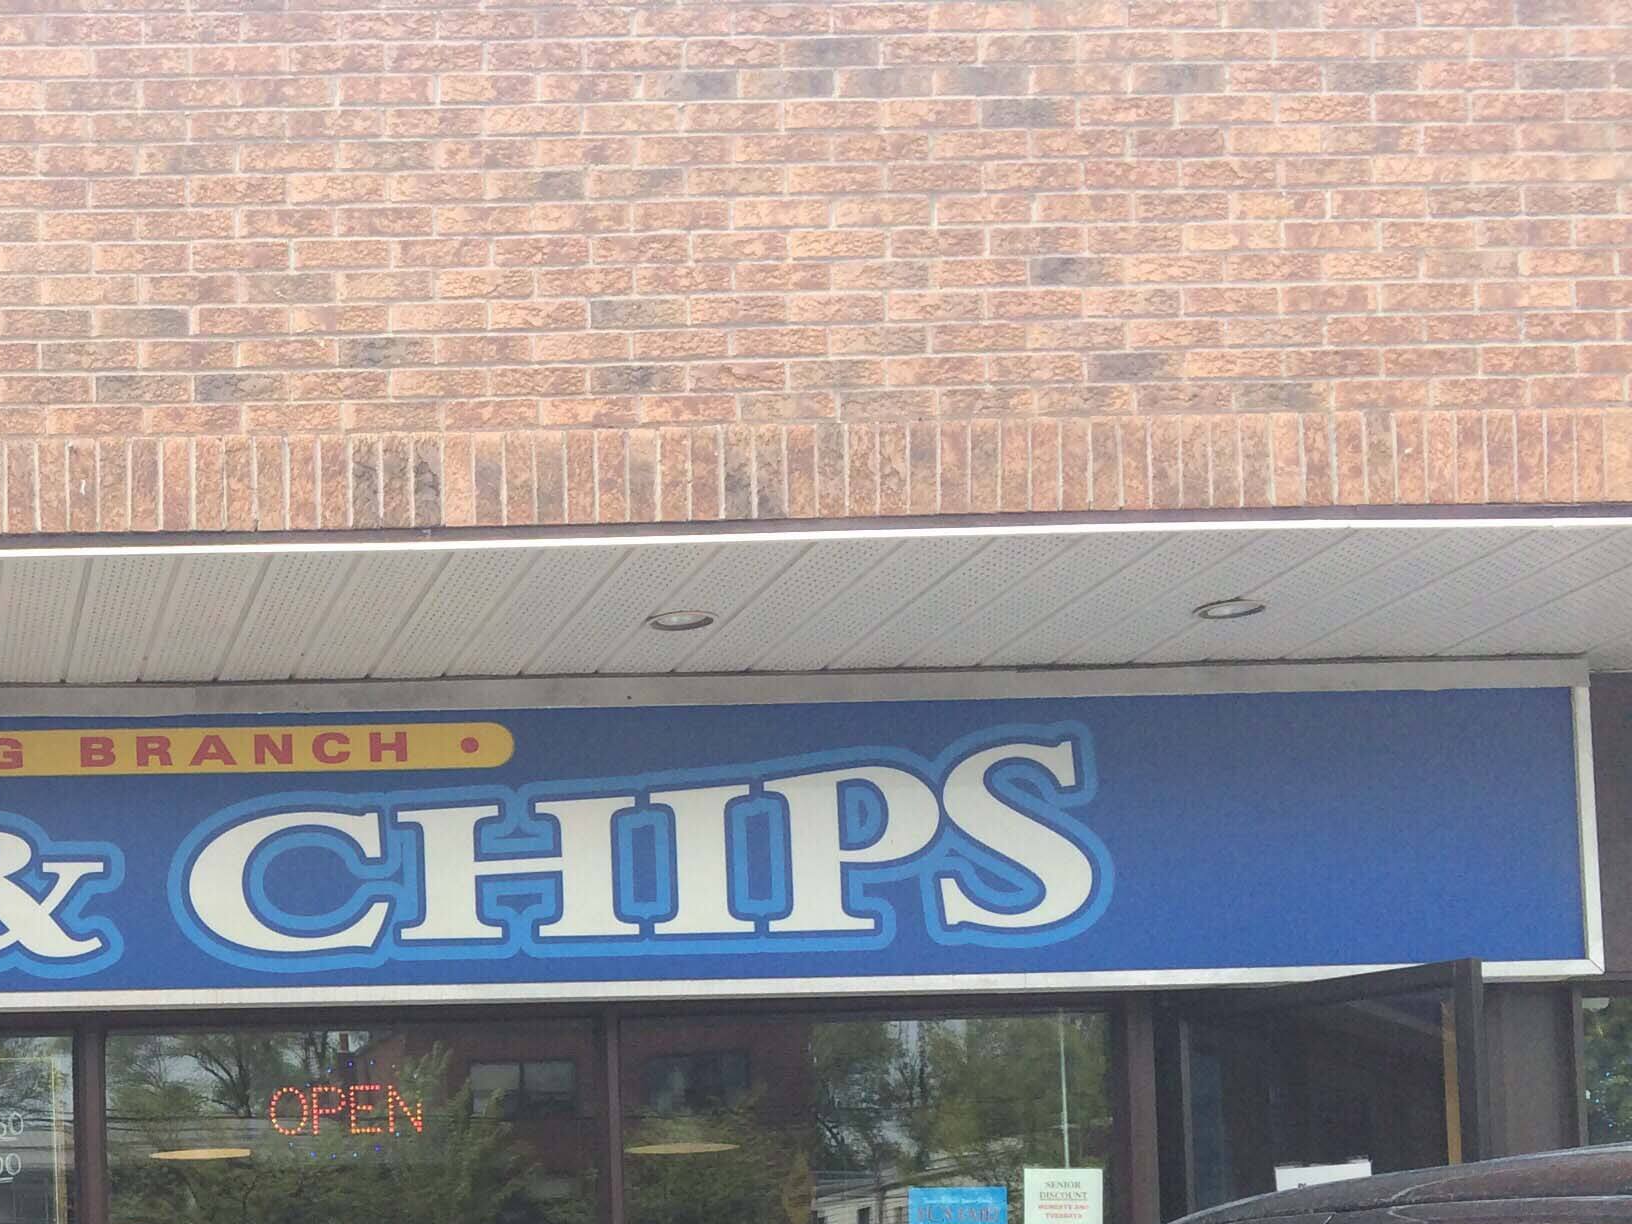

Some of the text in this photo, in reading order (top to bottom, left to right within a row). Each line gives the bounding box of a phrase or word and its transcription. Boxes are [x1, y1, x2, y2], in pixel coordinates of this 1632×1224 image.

[79, 731, 409, 769] BRANCH
[188, 741, 1094, 953] CHIPS
[270, 1084, 423, 1135] OPEN
[1039, 1191, 1088, 1200] DISCOUNT
[1044, 1180, 1082, 1189] SENIOR
